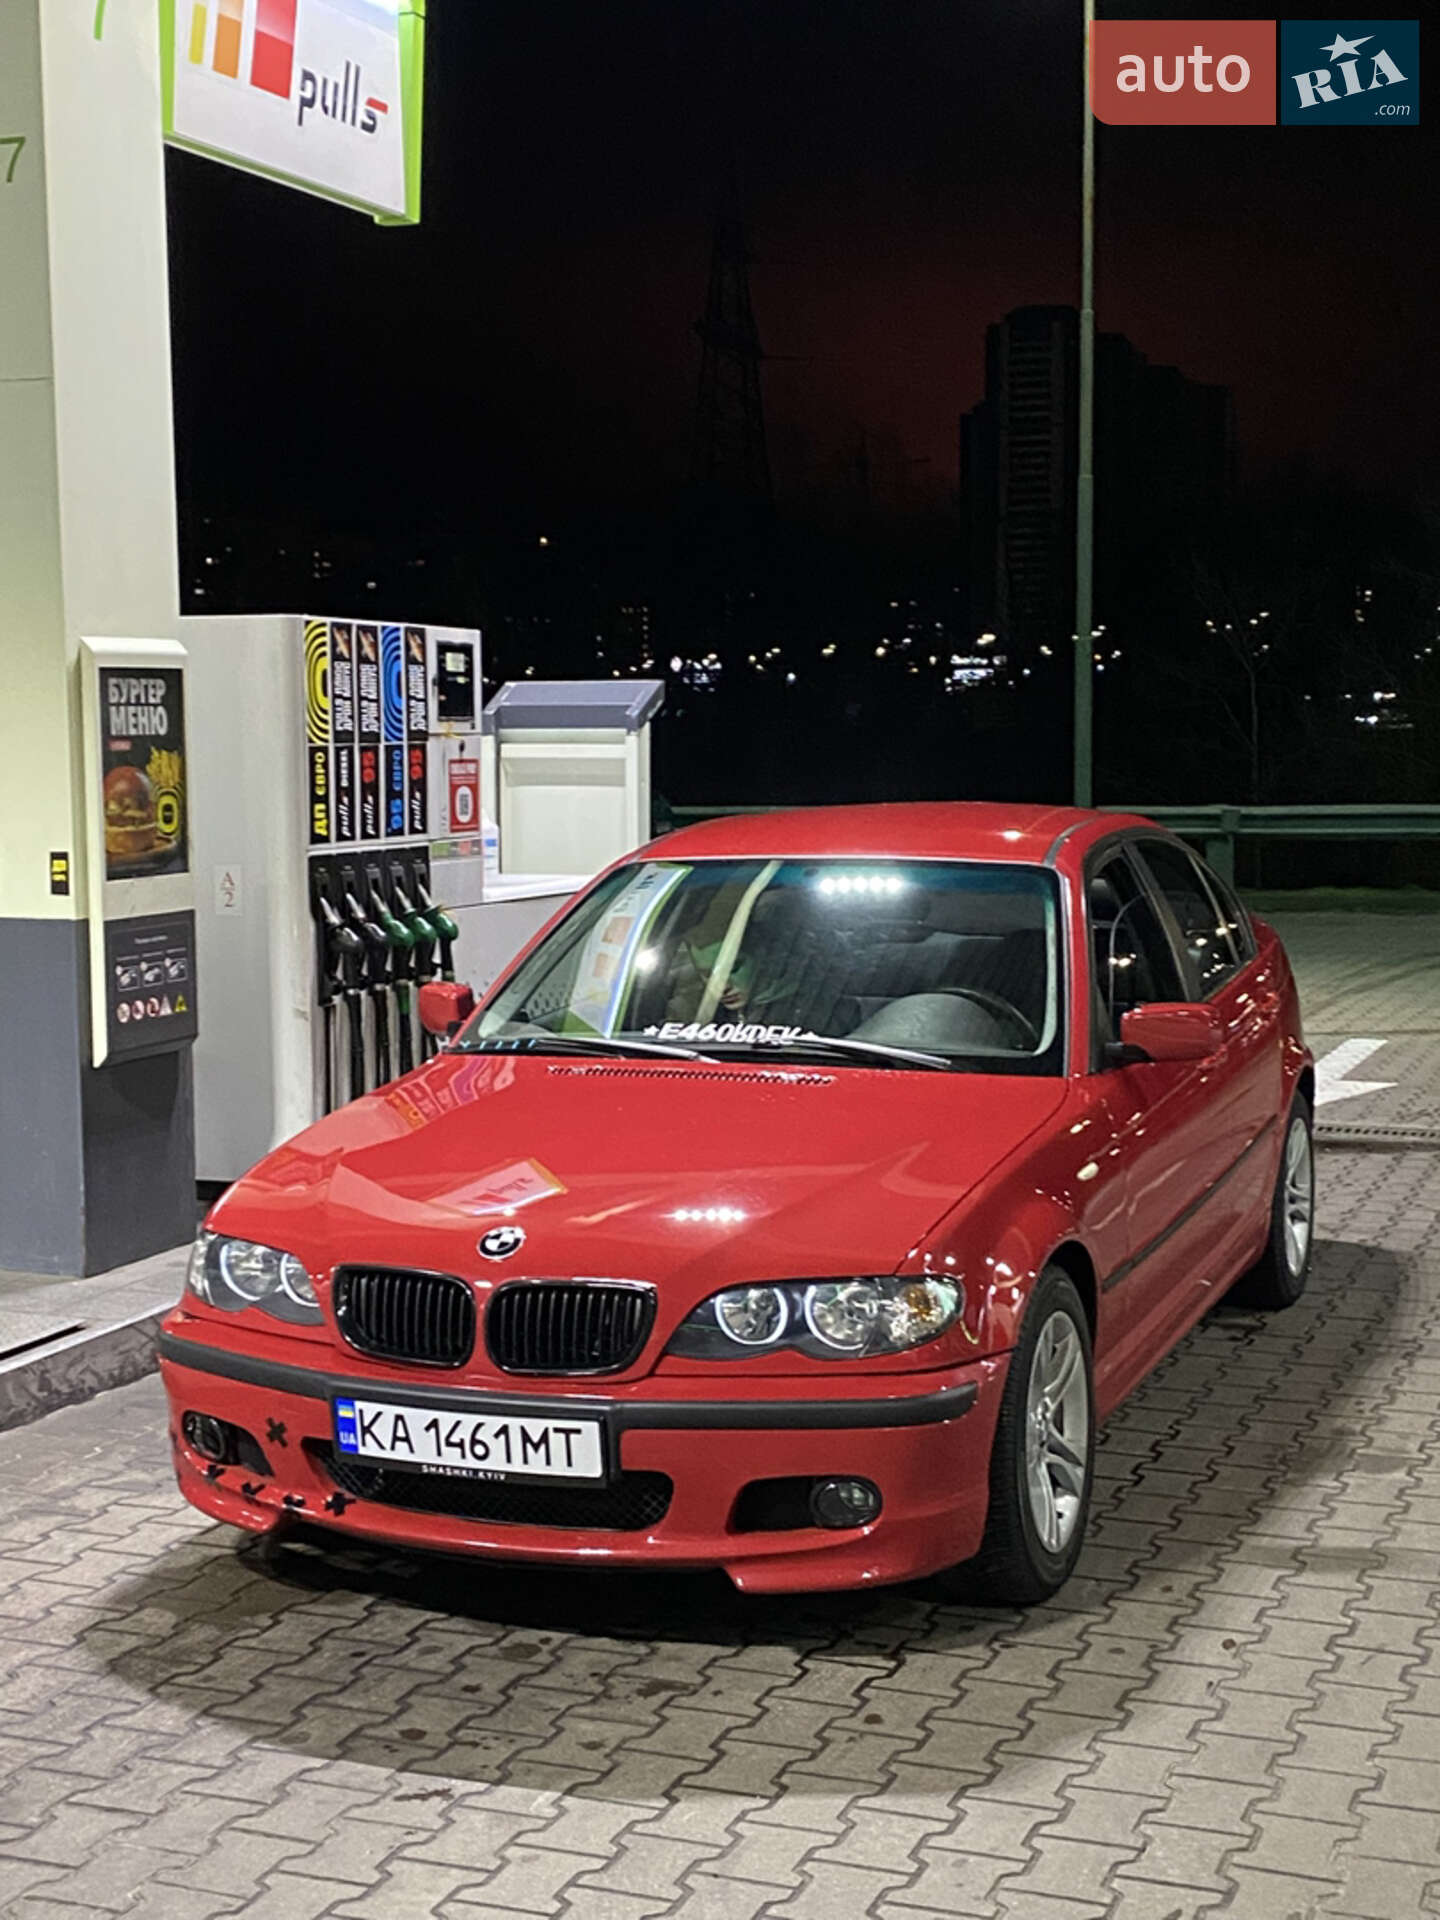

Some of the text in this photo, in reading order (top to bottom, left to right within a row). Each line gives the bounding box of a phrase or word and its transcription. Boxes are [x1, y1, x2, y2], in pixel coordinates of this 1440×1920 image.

[298, 59, 389, 134] pulls
[107, 677, 167, 704] БУРГЕР
[109, 705, 169, 736] МЕНЮ
[339, 1431, 357, 1446] UA
[358, 1408, 582, 1468] KA 1461 MT
